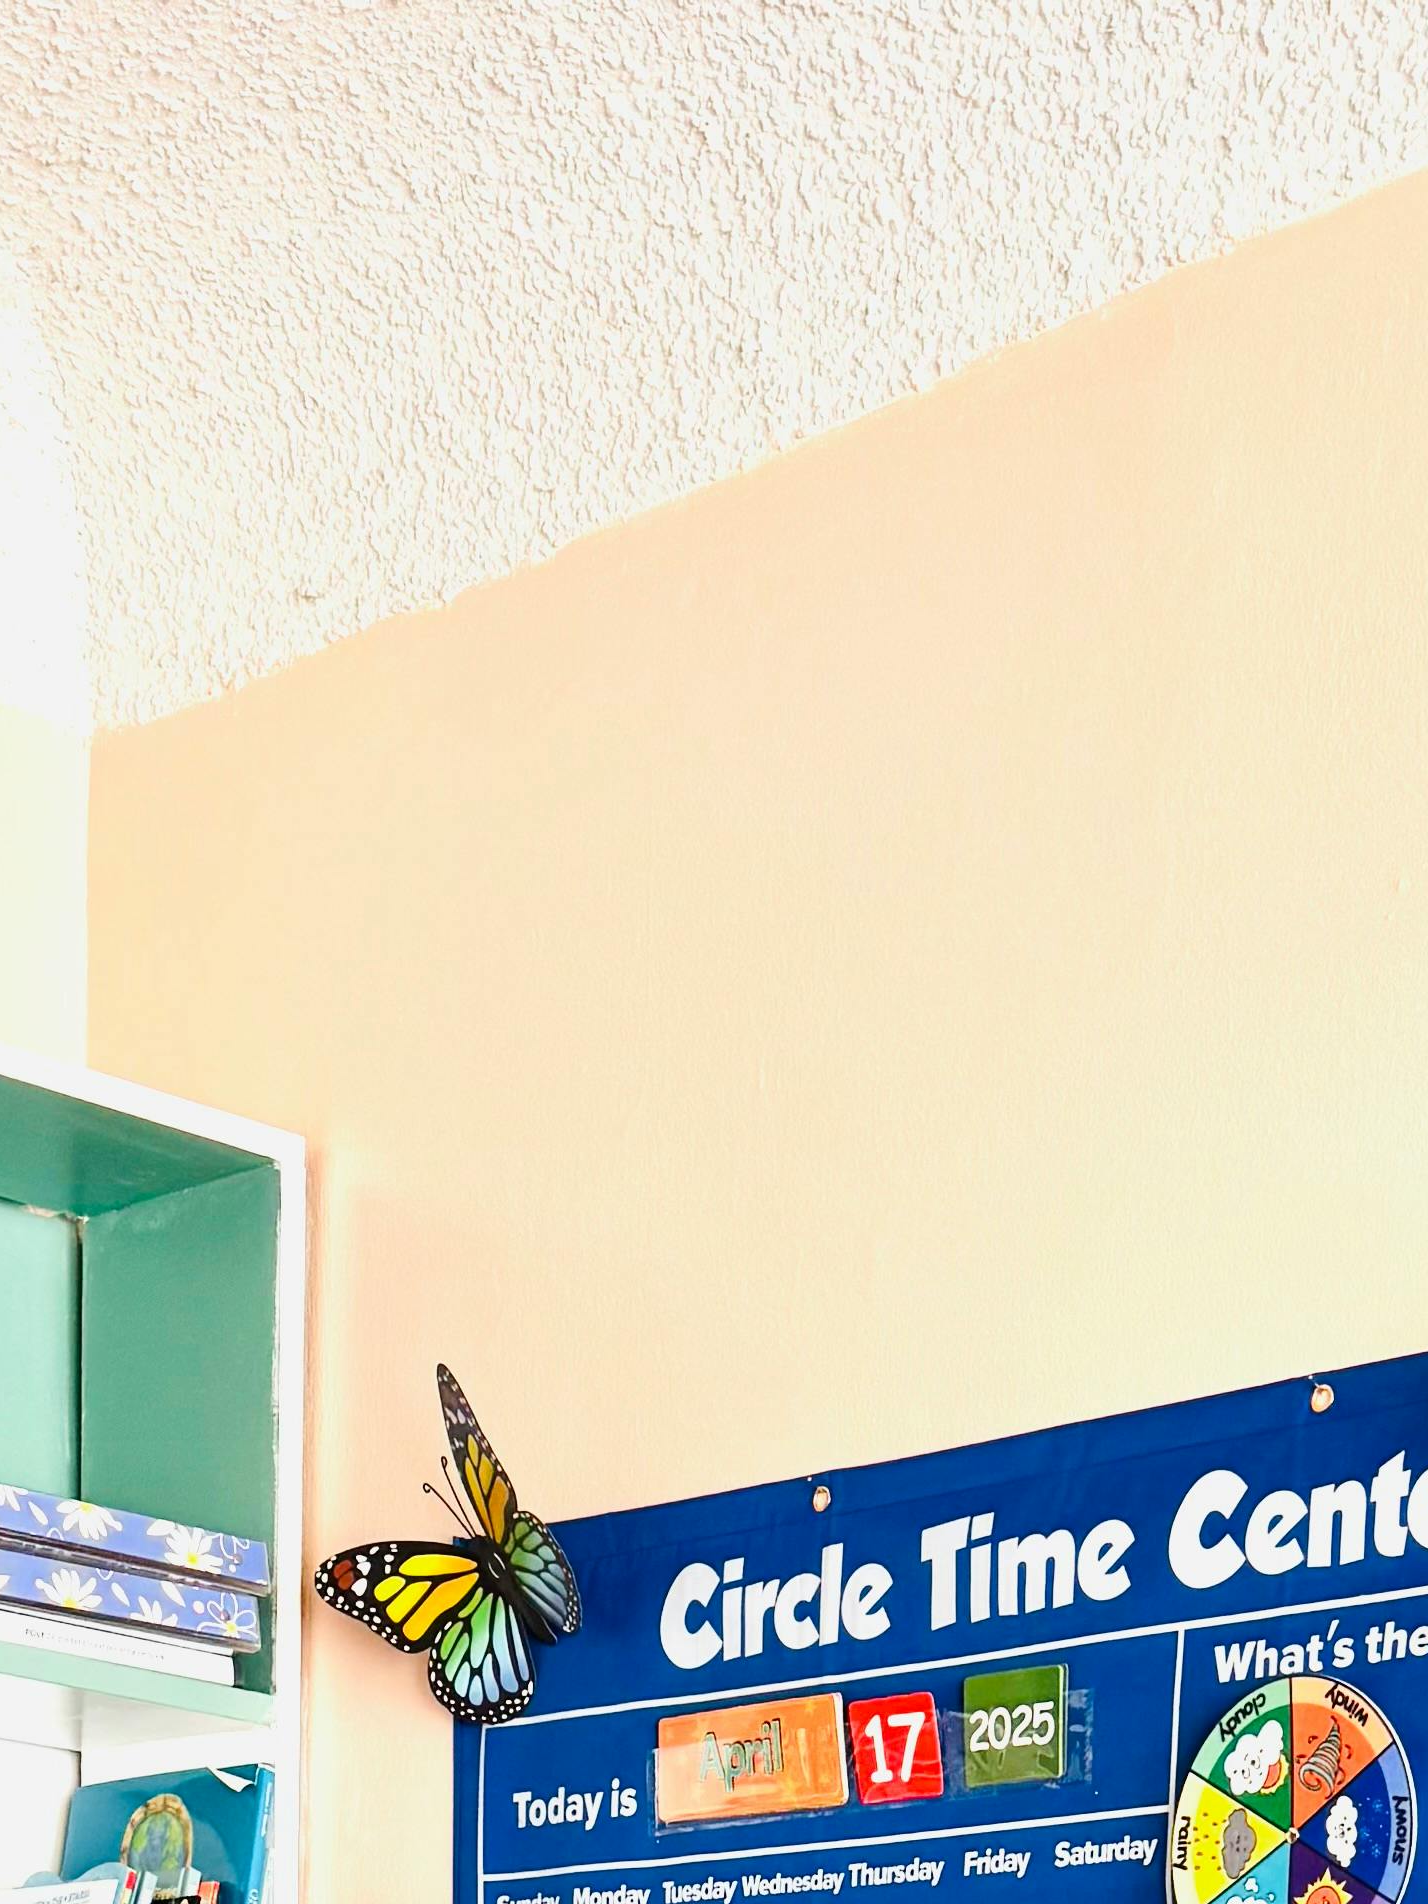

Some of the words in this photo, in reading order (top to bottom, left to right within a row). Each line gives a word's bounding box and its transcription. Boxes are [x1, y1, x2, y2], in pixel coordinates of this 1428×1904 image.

[659, 1543, 890, 1670] Circle
[921, 1512, 1135, 1631] Time
[1214, 1621, 1354, 1684] What's
[968, 1700, 1057, 1752] 2025
[1217, 1691, 1267, 1742] cloudy
[1325, 1684, 1369, 1725] windy
[700, 1719, 786, 1793] April
[869, 1713, 925, 1784] 17
[513, 1783, 603, 1830] Today
[609, 1779, 637, 1818] is
[1392, 1794, 1409, 1864] snowy
[741, 1867, 845, 1900] Wednesday
[848, 1856, 945, 1889] Thursday
[963, 1847, 1031, 1880] Friday
[1054, 1834, 1158, 1870] Saturday
[1173, 1814, 1190, 1872] rainy
